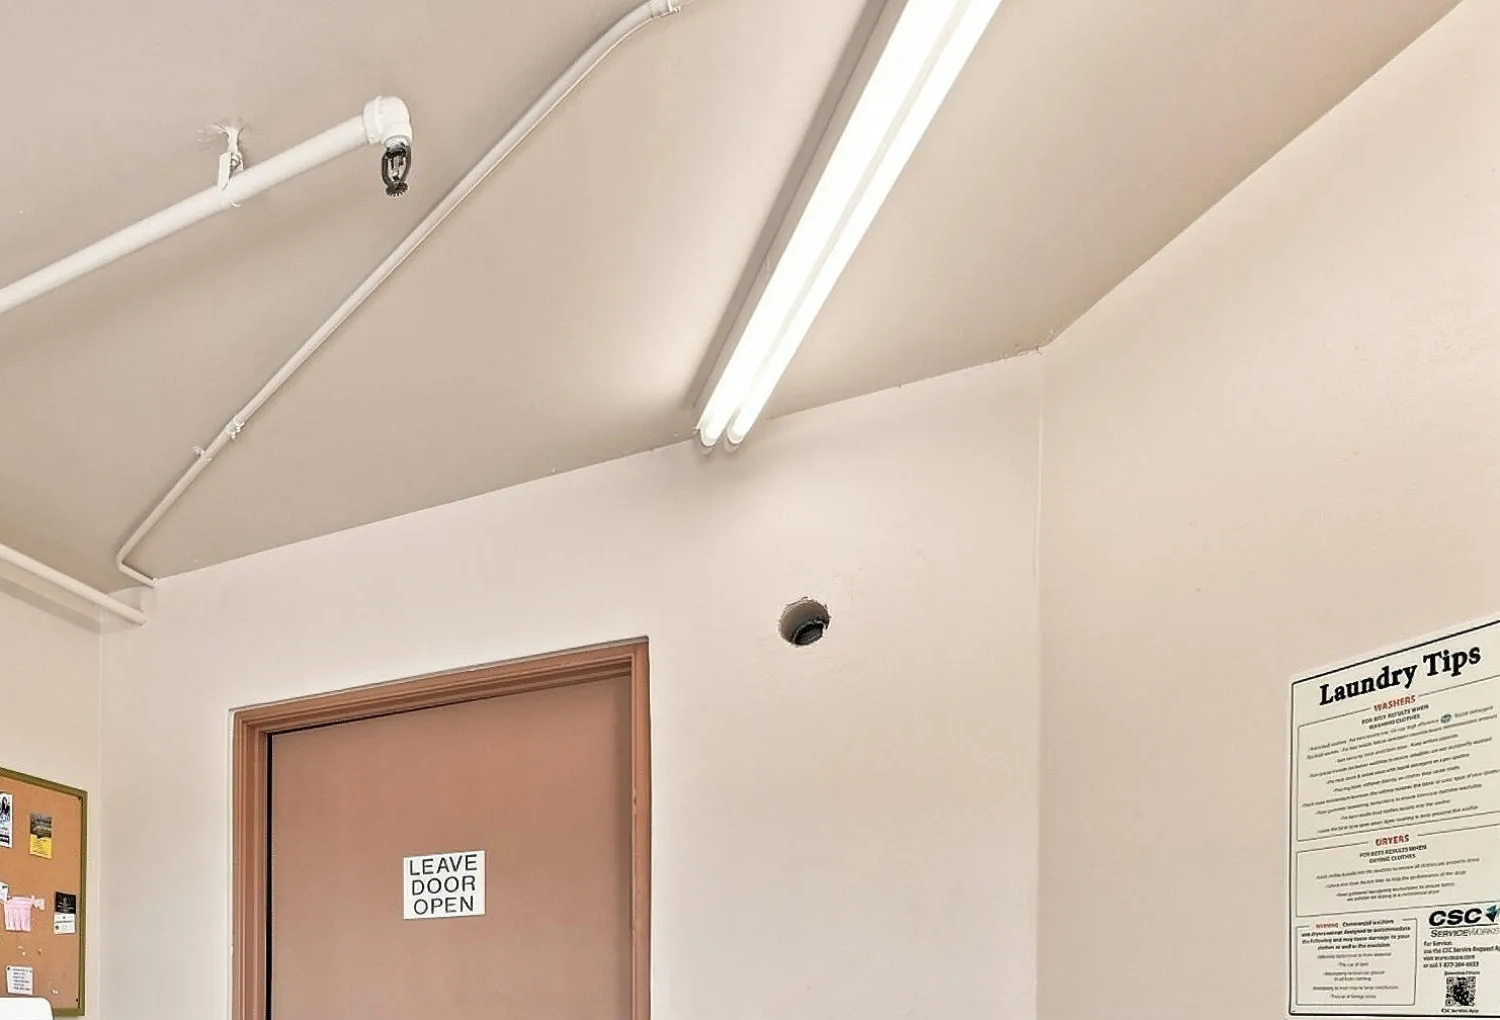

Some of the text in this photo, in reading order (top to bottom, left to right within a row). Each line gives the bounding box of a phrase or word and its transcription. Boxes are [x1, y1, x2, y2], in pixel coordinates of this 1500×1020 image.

[1319, 646, 1482, 706] Laundry Tips
[1373, 695, 1416, 712] WASHERS
[1411, 704, 1429, 713] WHEN
[1396, 713, 1420, 724] CLOTHES
[1375, 834, 1410, 847] DRYERS
[1409, 844, 1427, 852] WHEN
[410, 854, 478, 876] LEAVE
[1391, 853, 1416, 861] CLOTHES
[412, 875, 476, 896] DOOR
[414, 895, 474, 915] OPEN
[1429, 908, 1482, 926] CSC
